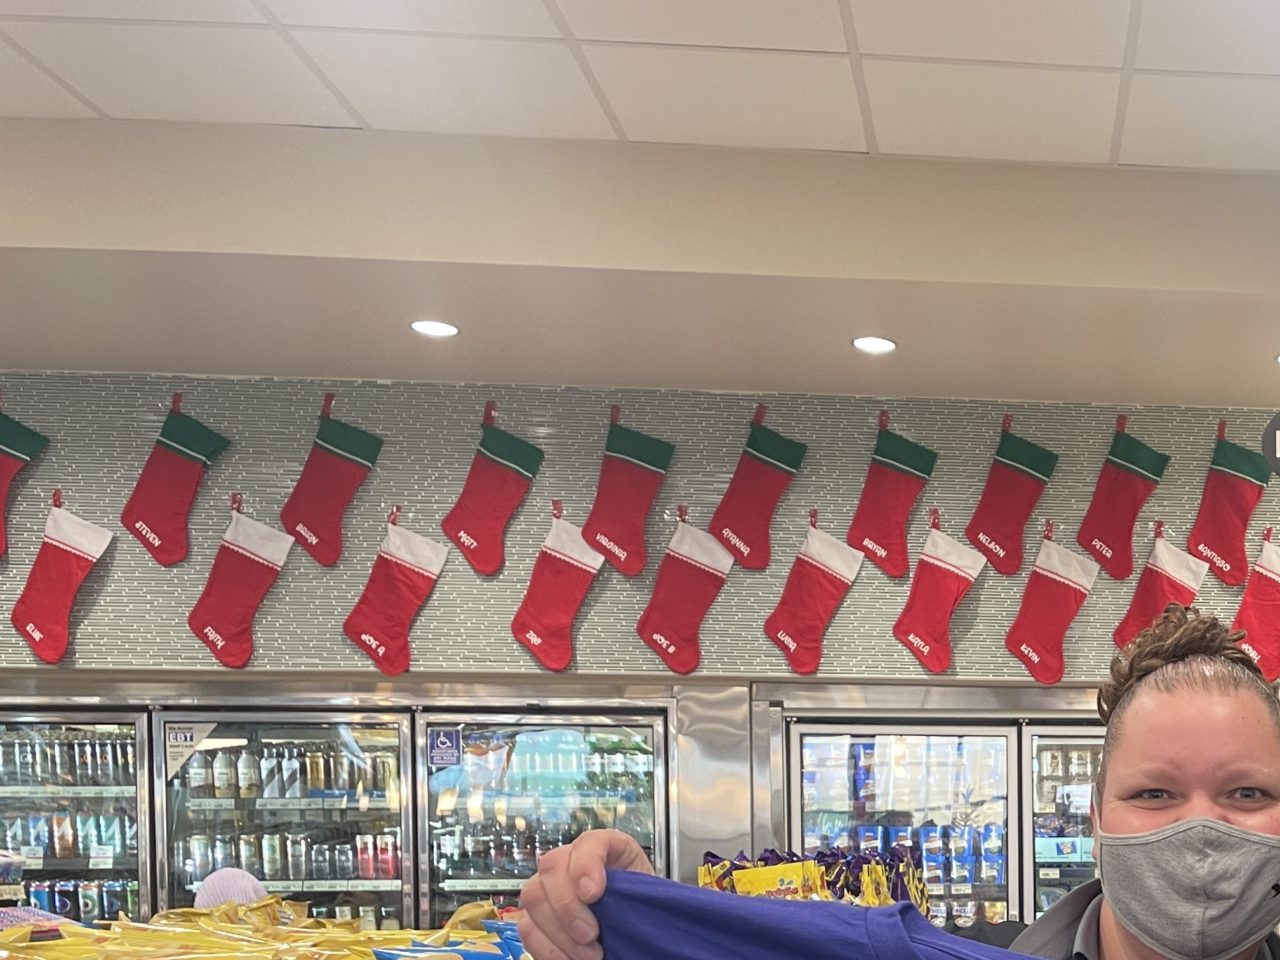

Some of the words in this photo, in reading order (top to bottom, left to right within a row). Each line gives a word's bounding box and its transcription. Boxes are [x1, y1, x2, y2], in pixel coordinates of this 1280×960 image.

[135, 520, 162, 548] STEVEN
[457, 530, 478, 550] MATT
[977, 531, 1006, 558] NELSON
[595, 532, 628, 562] VIRGINIA
[1091, 537, 1113, 559] PETER
[1019, 643, 1041, 664] KEVIN
[168, 732, 194, 743] EBT
